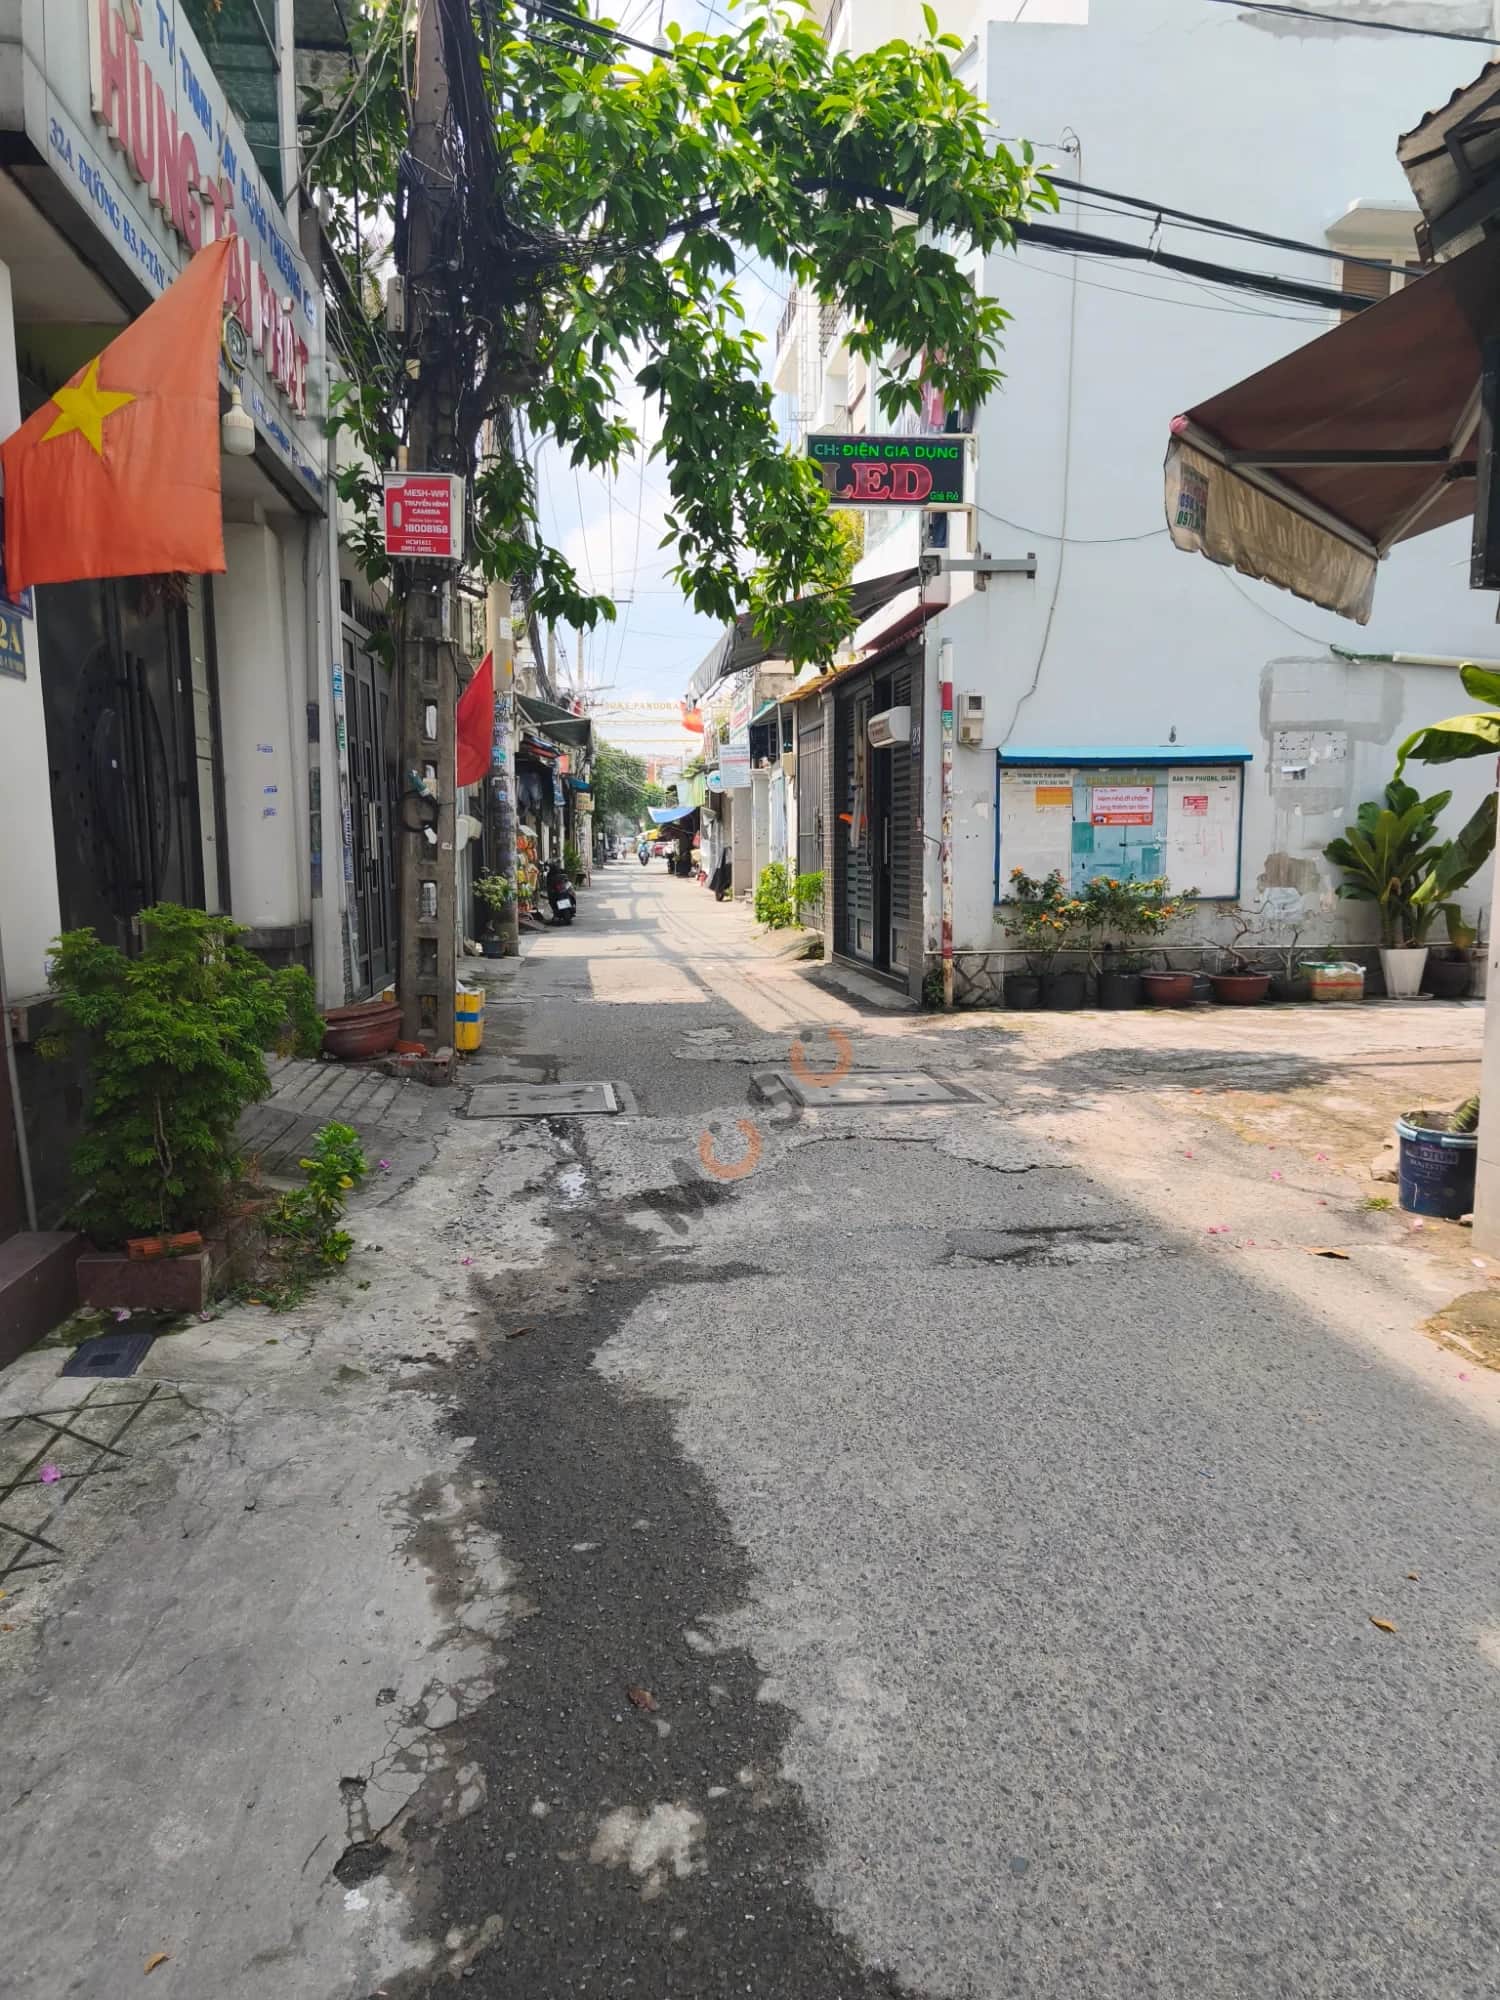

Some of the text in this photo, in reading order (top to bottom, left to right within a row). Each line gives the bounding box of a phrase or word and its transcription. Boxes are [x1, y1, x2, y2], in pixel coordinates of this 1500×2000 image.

[814, 442, 958, 460] CH: ĐIỆN GIA DỤNG
[821, 462, 933, 500] LED
